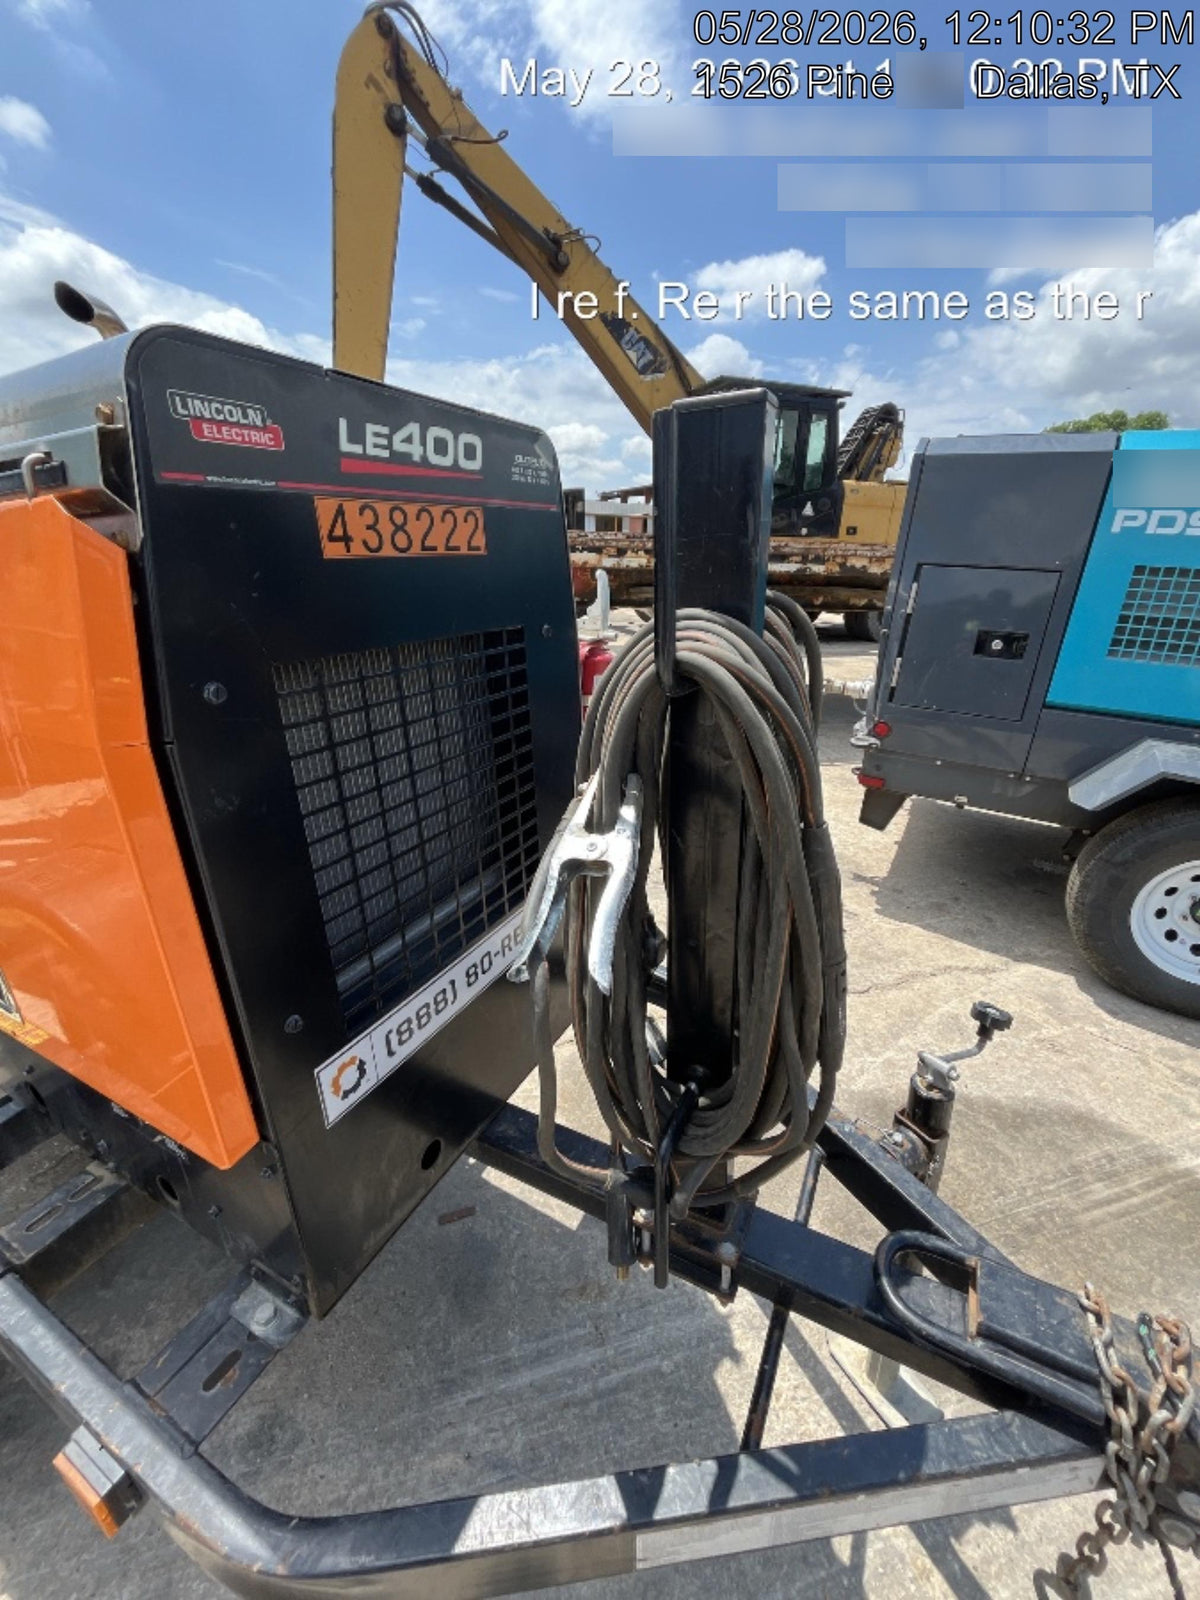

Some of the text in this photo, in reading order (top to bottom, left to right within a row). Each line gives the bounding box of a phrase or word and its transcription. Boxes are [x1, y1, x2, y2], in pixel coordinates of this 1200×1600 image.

[175, 396, 263, 427] LINCOLN
[202, 422, 275, 445] ELECTRIC
[338, 417, 483, 471] LE400
[327, 502, 482, 553] 438222
[384, 978, 458, 1058] (888)
